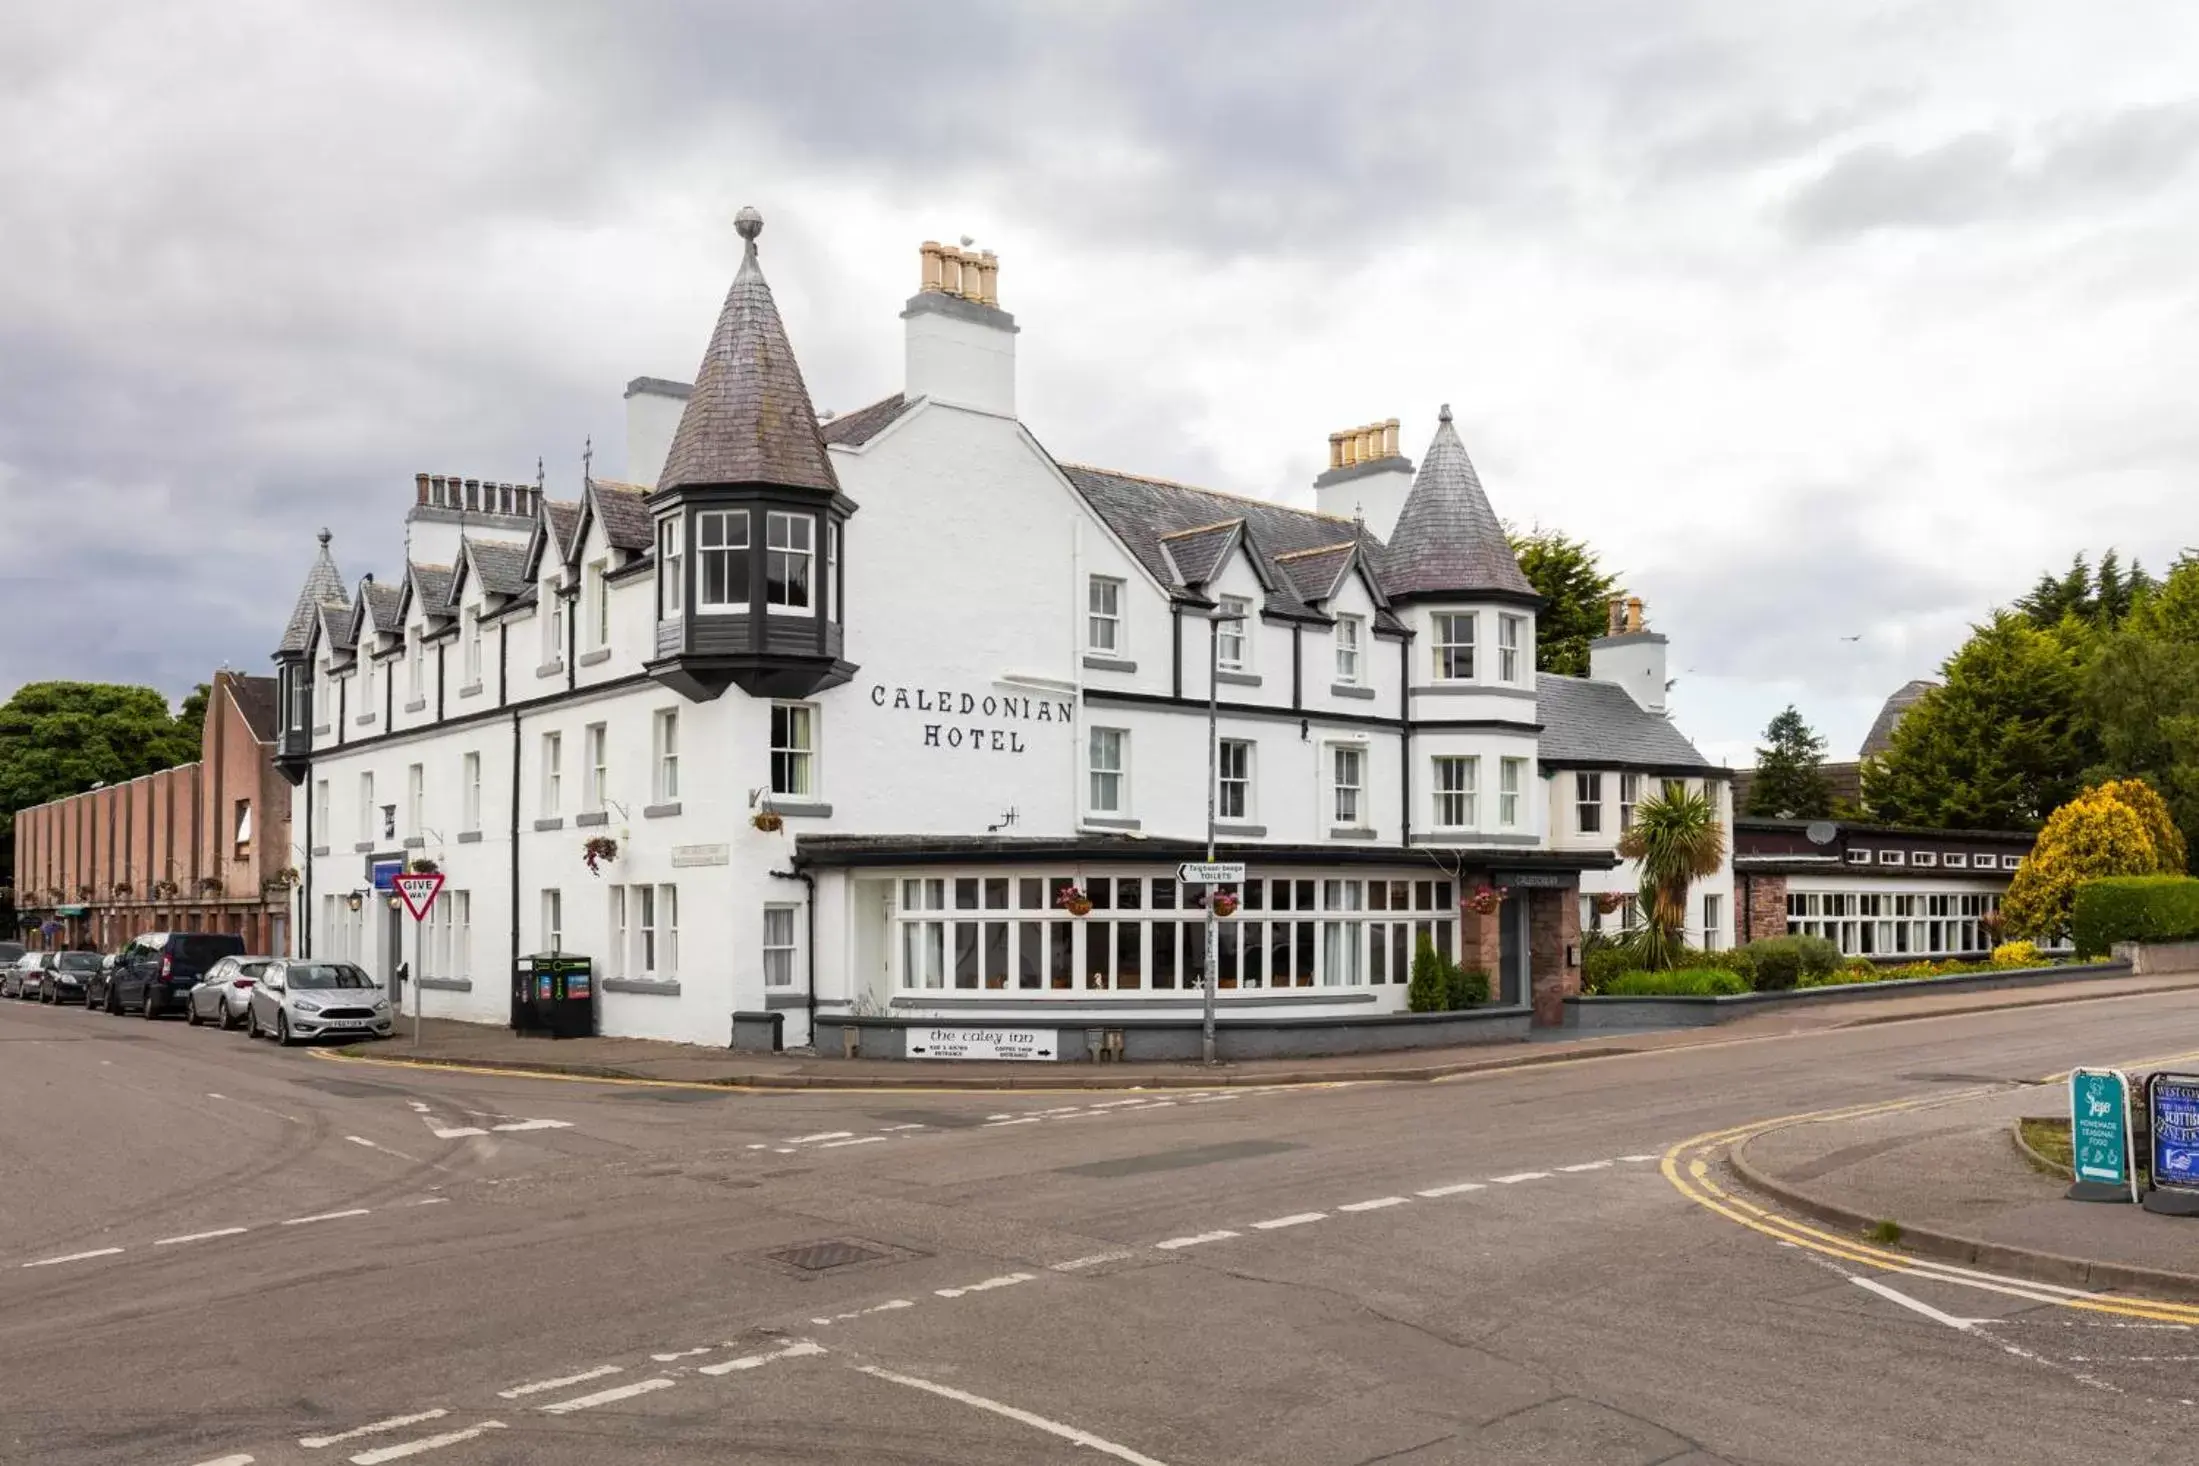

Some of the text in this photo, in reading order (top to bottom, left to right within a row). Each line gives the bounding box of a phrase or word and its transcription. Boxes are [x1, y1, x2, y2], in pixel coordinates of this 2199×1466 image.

[871, 685, 1073, 723] CALEDONIAN
[924, 724, 1025, 753] HOTEL
[404, 881, 432, 890] GIVE
[930, 1030, 1034, 1045] the caley inn
[2156, 1087, 2180, 1097] WEST
[2080, 1120, 2117, 1131] HOMEMADE
[2082, 1129, 2115, 1139] SEASONAL
[2089, 1137, 2109, 1146] FOOD
